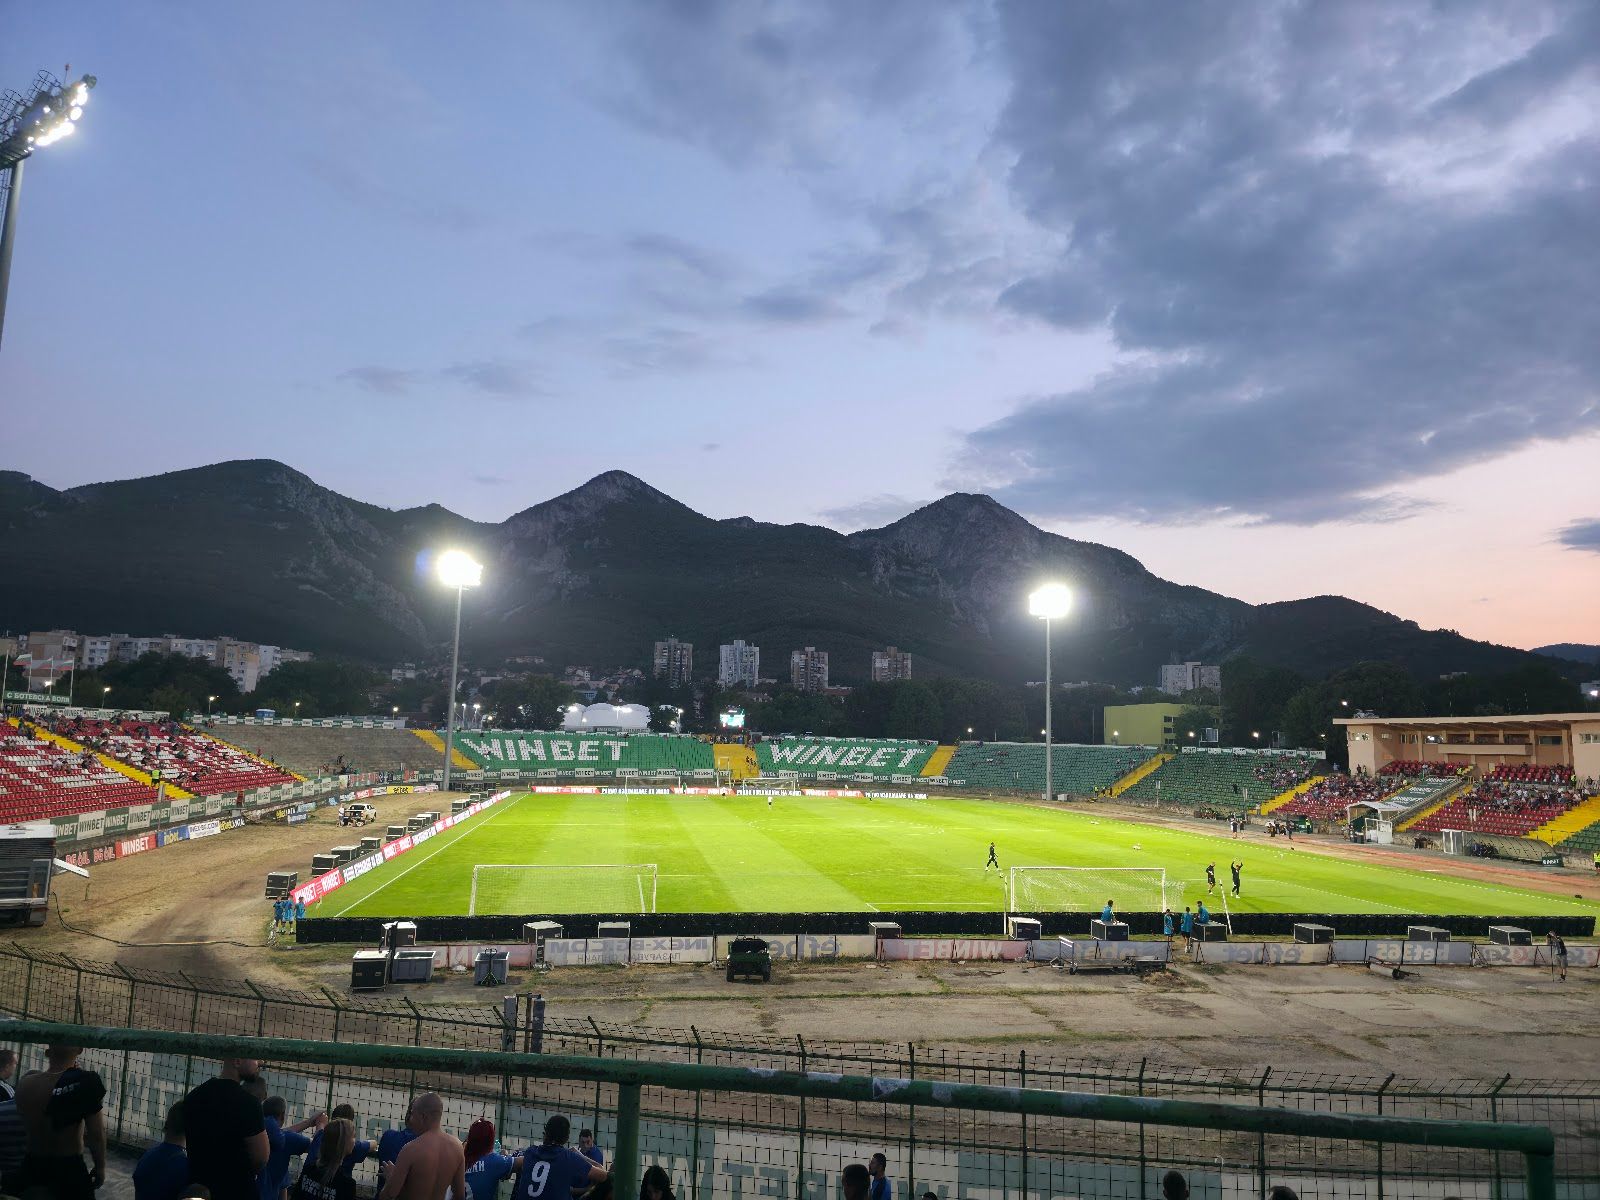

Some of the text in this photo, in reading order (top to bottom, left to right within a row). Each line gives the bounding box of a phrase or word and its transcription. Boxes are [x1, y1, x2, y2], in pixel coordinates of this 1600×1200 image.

[461, 738, 628, 761] WINBET
[770, 744, 926, 768] WINBET
[79, 818, 104, 833] WINBET
[105, 814, 129, 828] WINBET
[129, 811, 151, 824] WINBET
[121, 837, 150, 856] WINBET
[527, 1160, 551, 1198] 9
